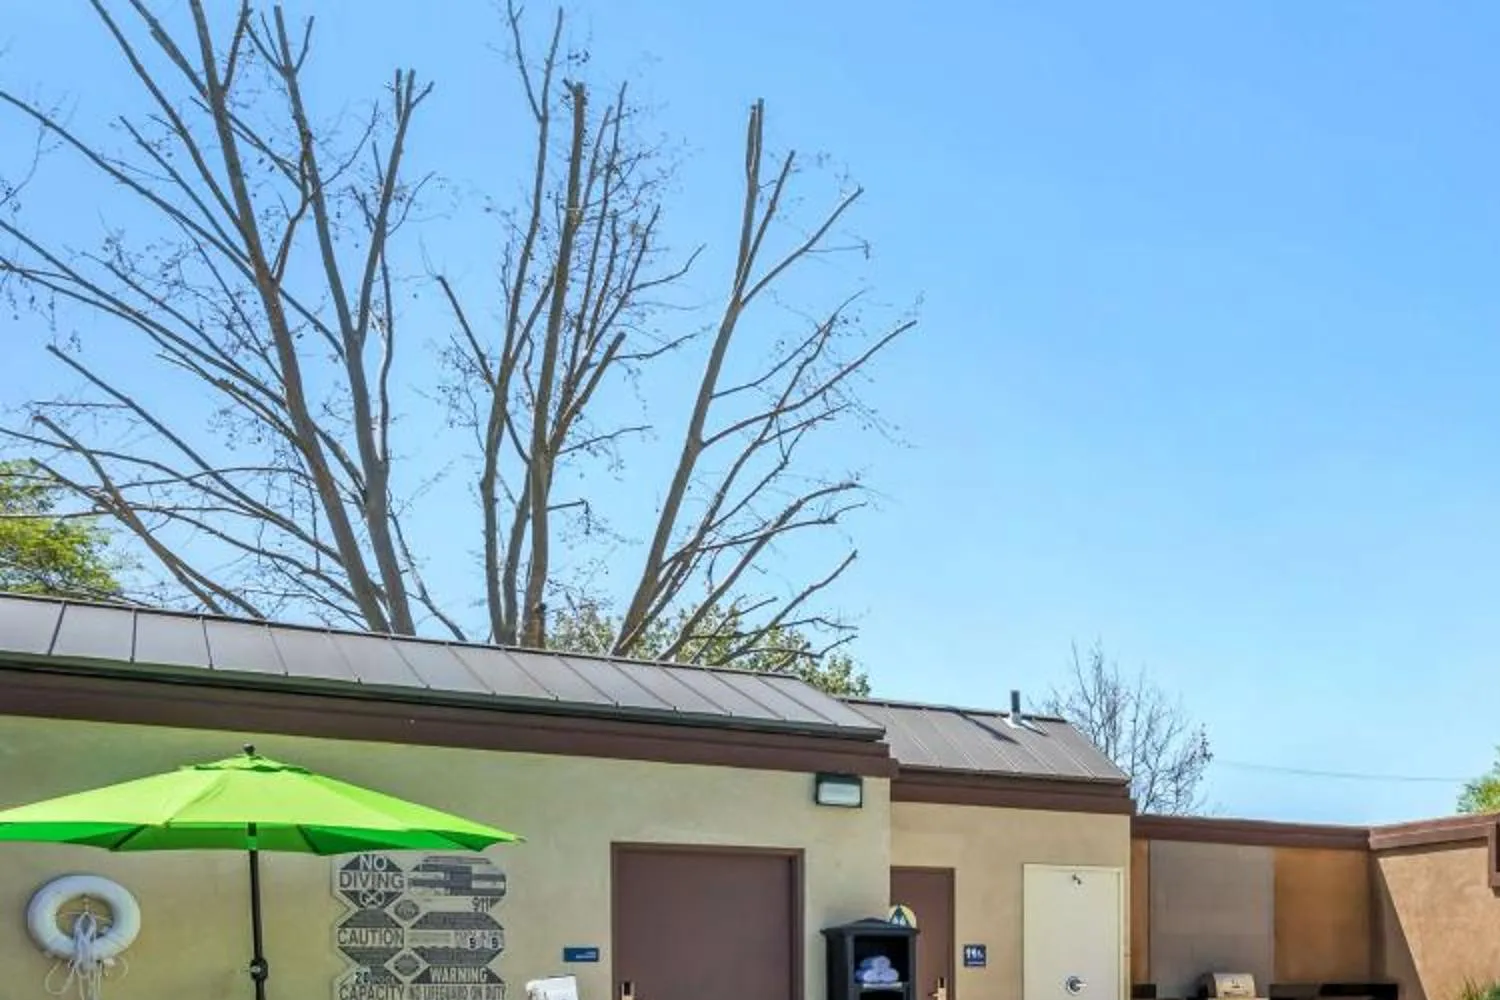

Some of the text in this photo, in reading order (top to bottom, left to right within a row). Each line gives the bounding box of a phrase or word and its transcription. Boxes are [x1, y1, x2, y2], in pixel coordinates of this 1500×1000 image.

[359, 855, 387, 870] NO
[339, 872, 404, 889] DIVING
[337, 927, 404, 945] CAUTION
[429, 967, 488, 983] WARNING
